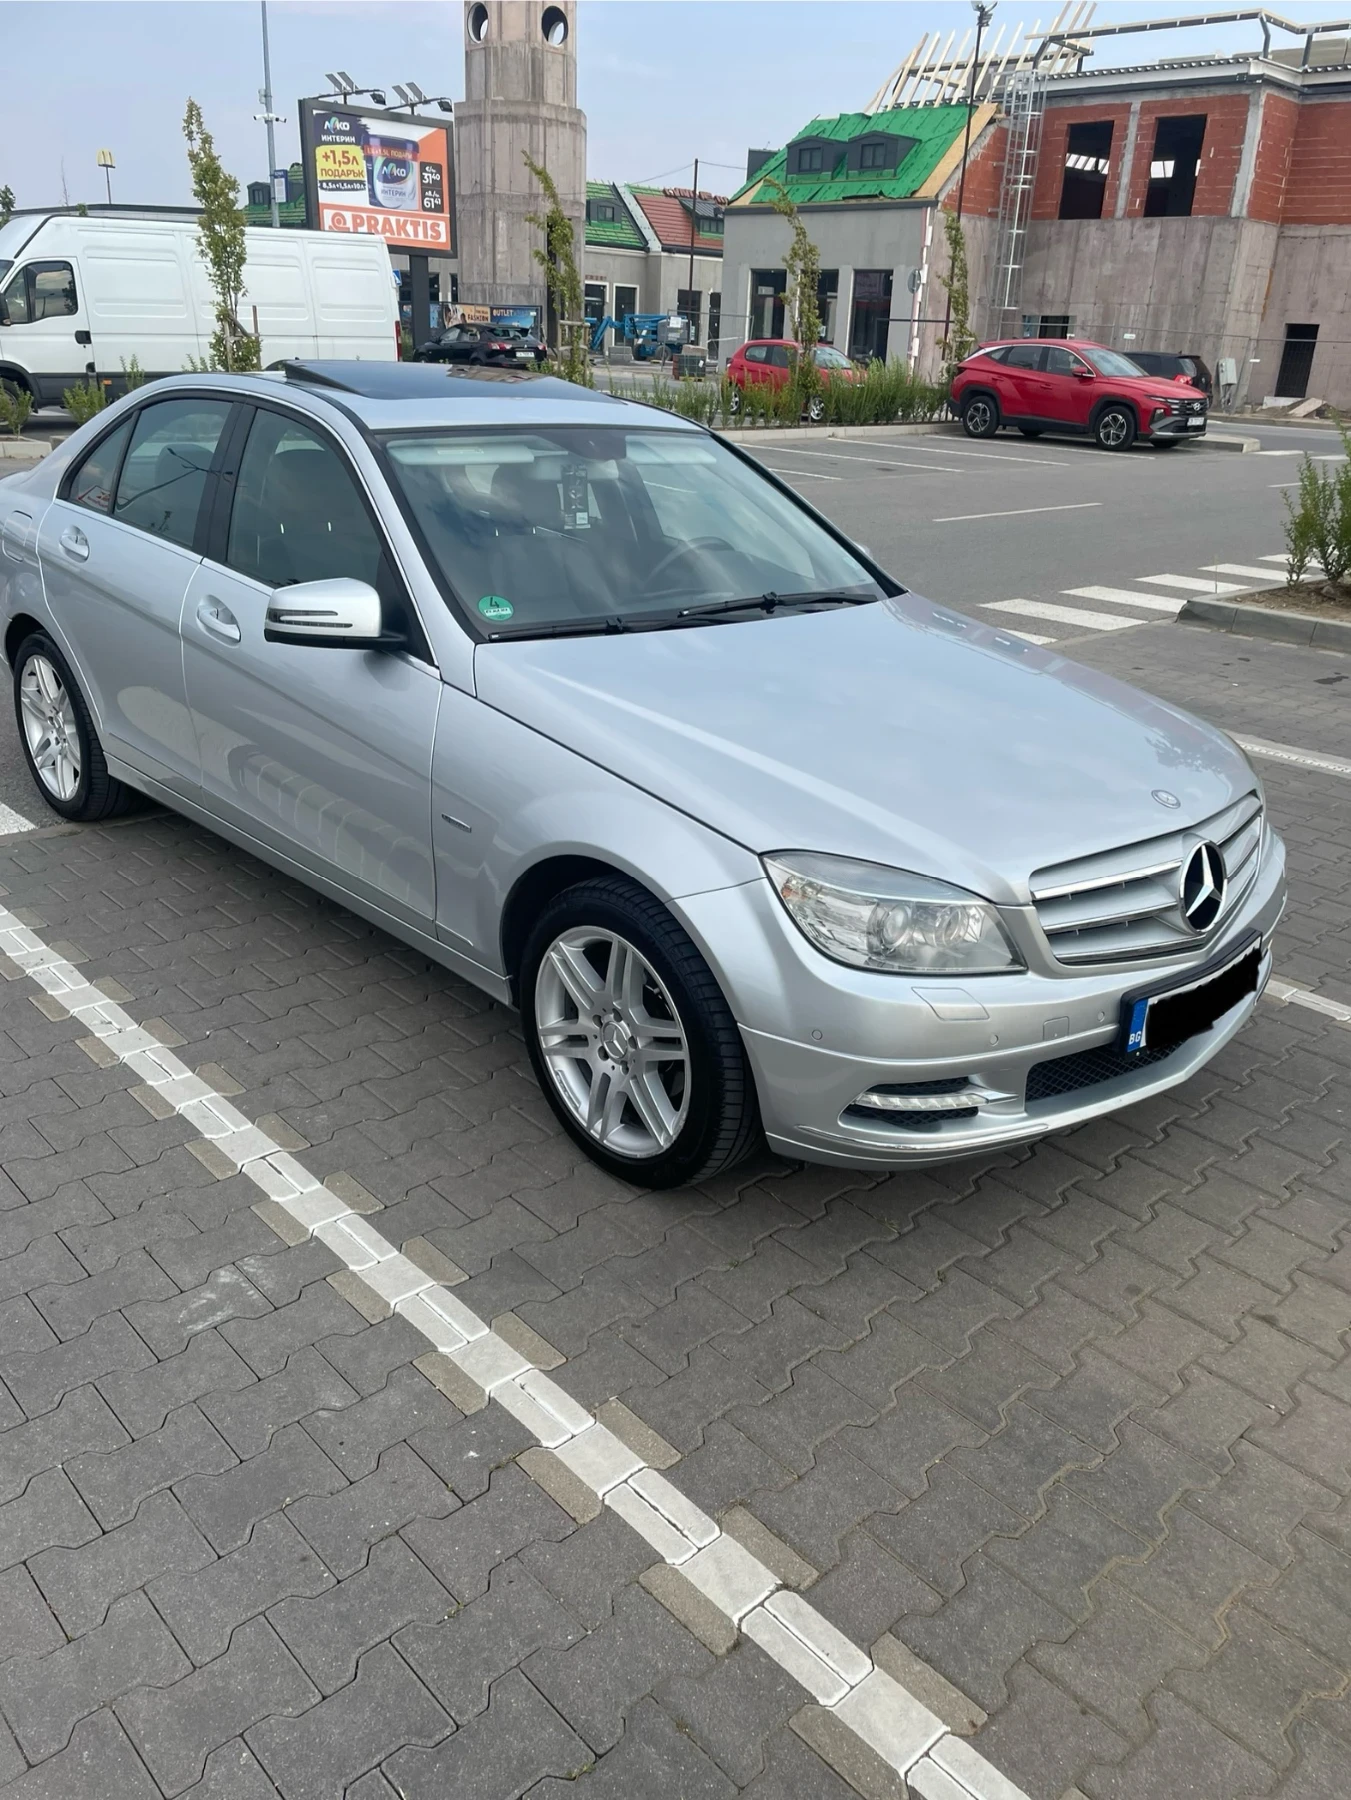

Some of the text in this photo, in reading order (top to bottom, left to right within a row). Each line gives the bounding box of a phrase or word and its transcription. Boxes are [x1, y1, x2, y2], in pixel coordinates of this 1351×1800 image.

[321, 134, 356, 144] ИНТЕРИН
[320, 168, 365, 179] ПОДАРЪК
[351, 213, 442, 241] PRAKTIS
[467, 313, 489, 322] FASHION
[492, 308, 514, 317] OUTLET
[490, 596, 500, 609] 4
[1128, 1031, 1142, 1045] BG
